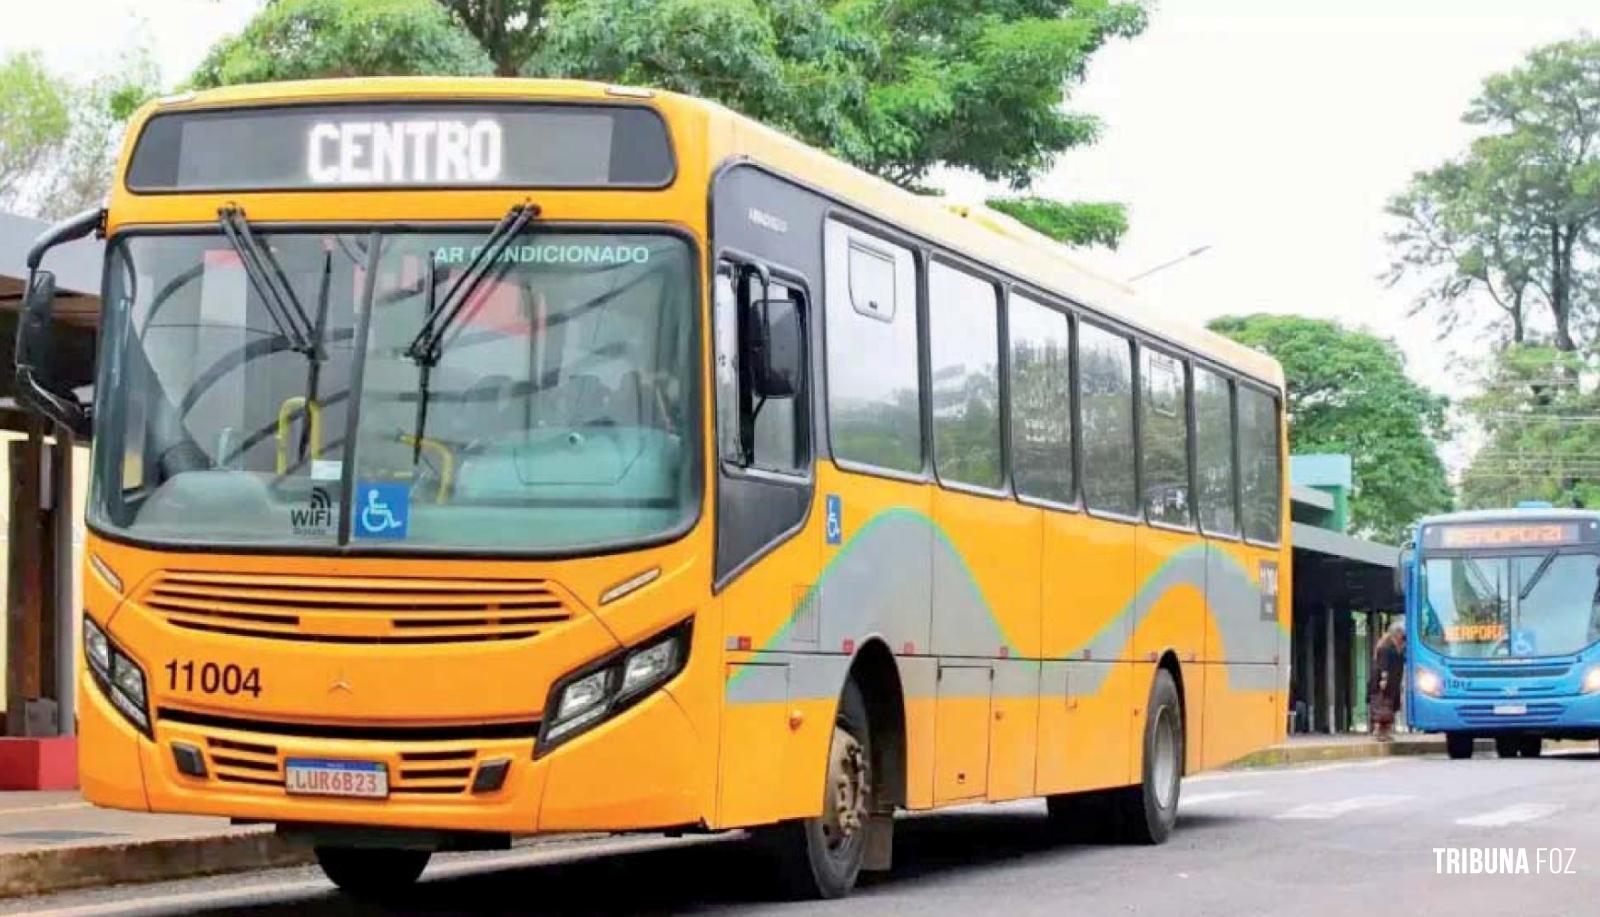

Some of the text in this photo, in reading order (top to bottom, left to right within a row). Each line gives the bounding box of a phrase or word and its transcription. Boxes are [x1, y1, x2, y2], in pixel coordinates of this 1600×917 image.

[308, 120, 502, 182] CENTRO
[434, 247, 463, 263] AR
[164, 659, 264, 698] 11004
[295, 768, 377, 793] LUR6B23
